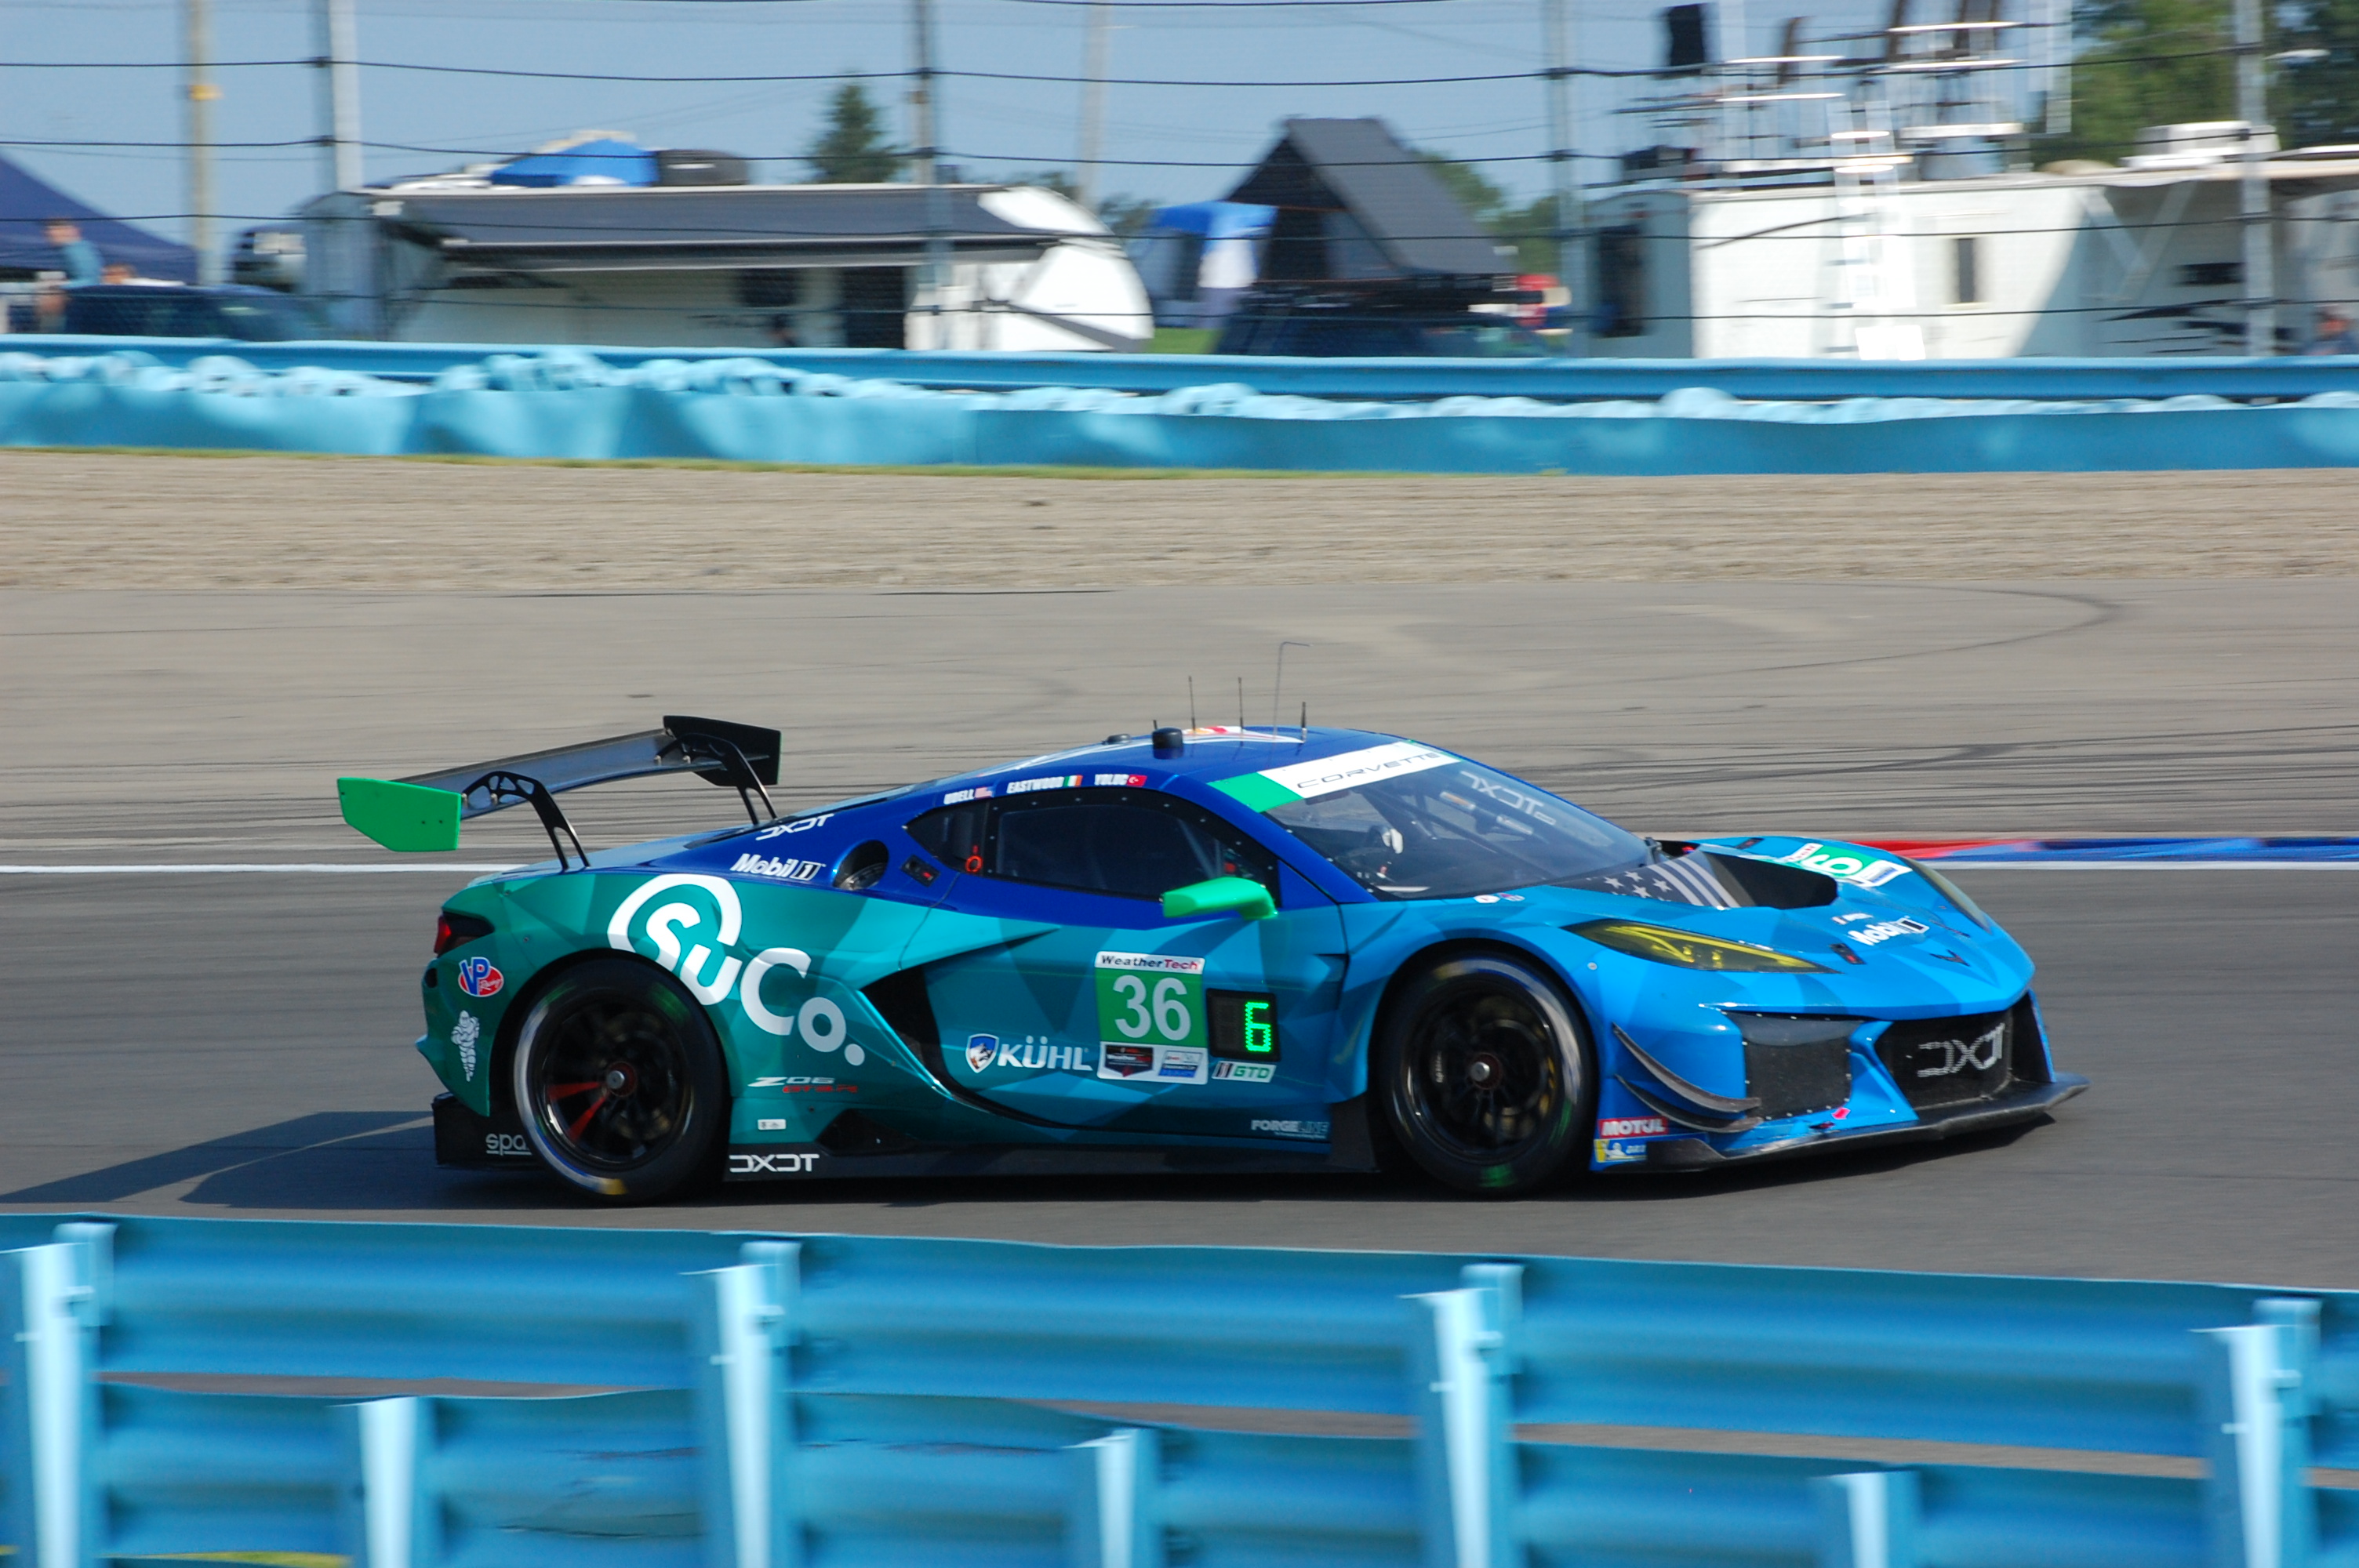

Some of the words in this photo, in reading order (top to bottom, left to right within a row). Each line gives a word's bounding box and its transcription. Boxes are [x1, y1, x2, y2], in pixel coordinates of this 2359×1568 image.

[1296, 752, 1441, 789] CORVETTE
[729, 853, 799, 878] Mobil
[458, 956, 491, 996] VP
[1100, 954, 1200, 971] WeatherTech
[1112, 975, 1191, 1041] 36
[1245, 1001, 1272, 1052] 6
[997, 1035, 1093, 1071] KÜHL
[747, 1076, 835, 1087] Z06
[1233, 1065, 1271, 1080] GTD
[1601, 1118, 1667, 1136] MOTUL
